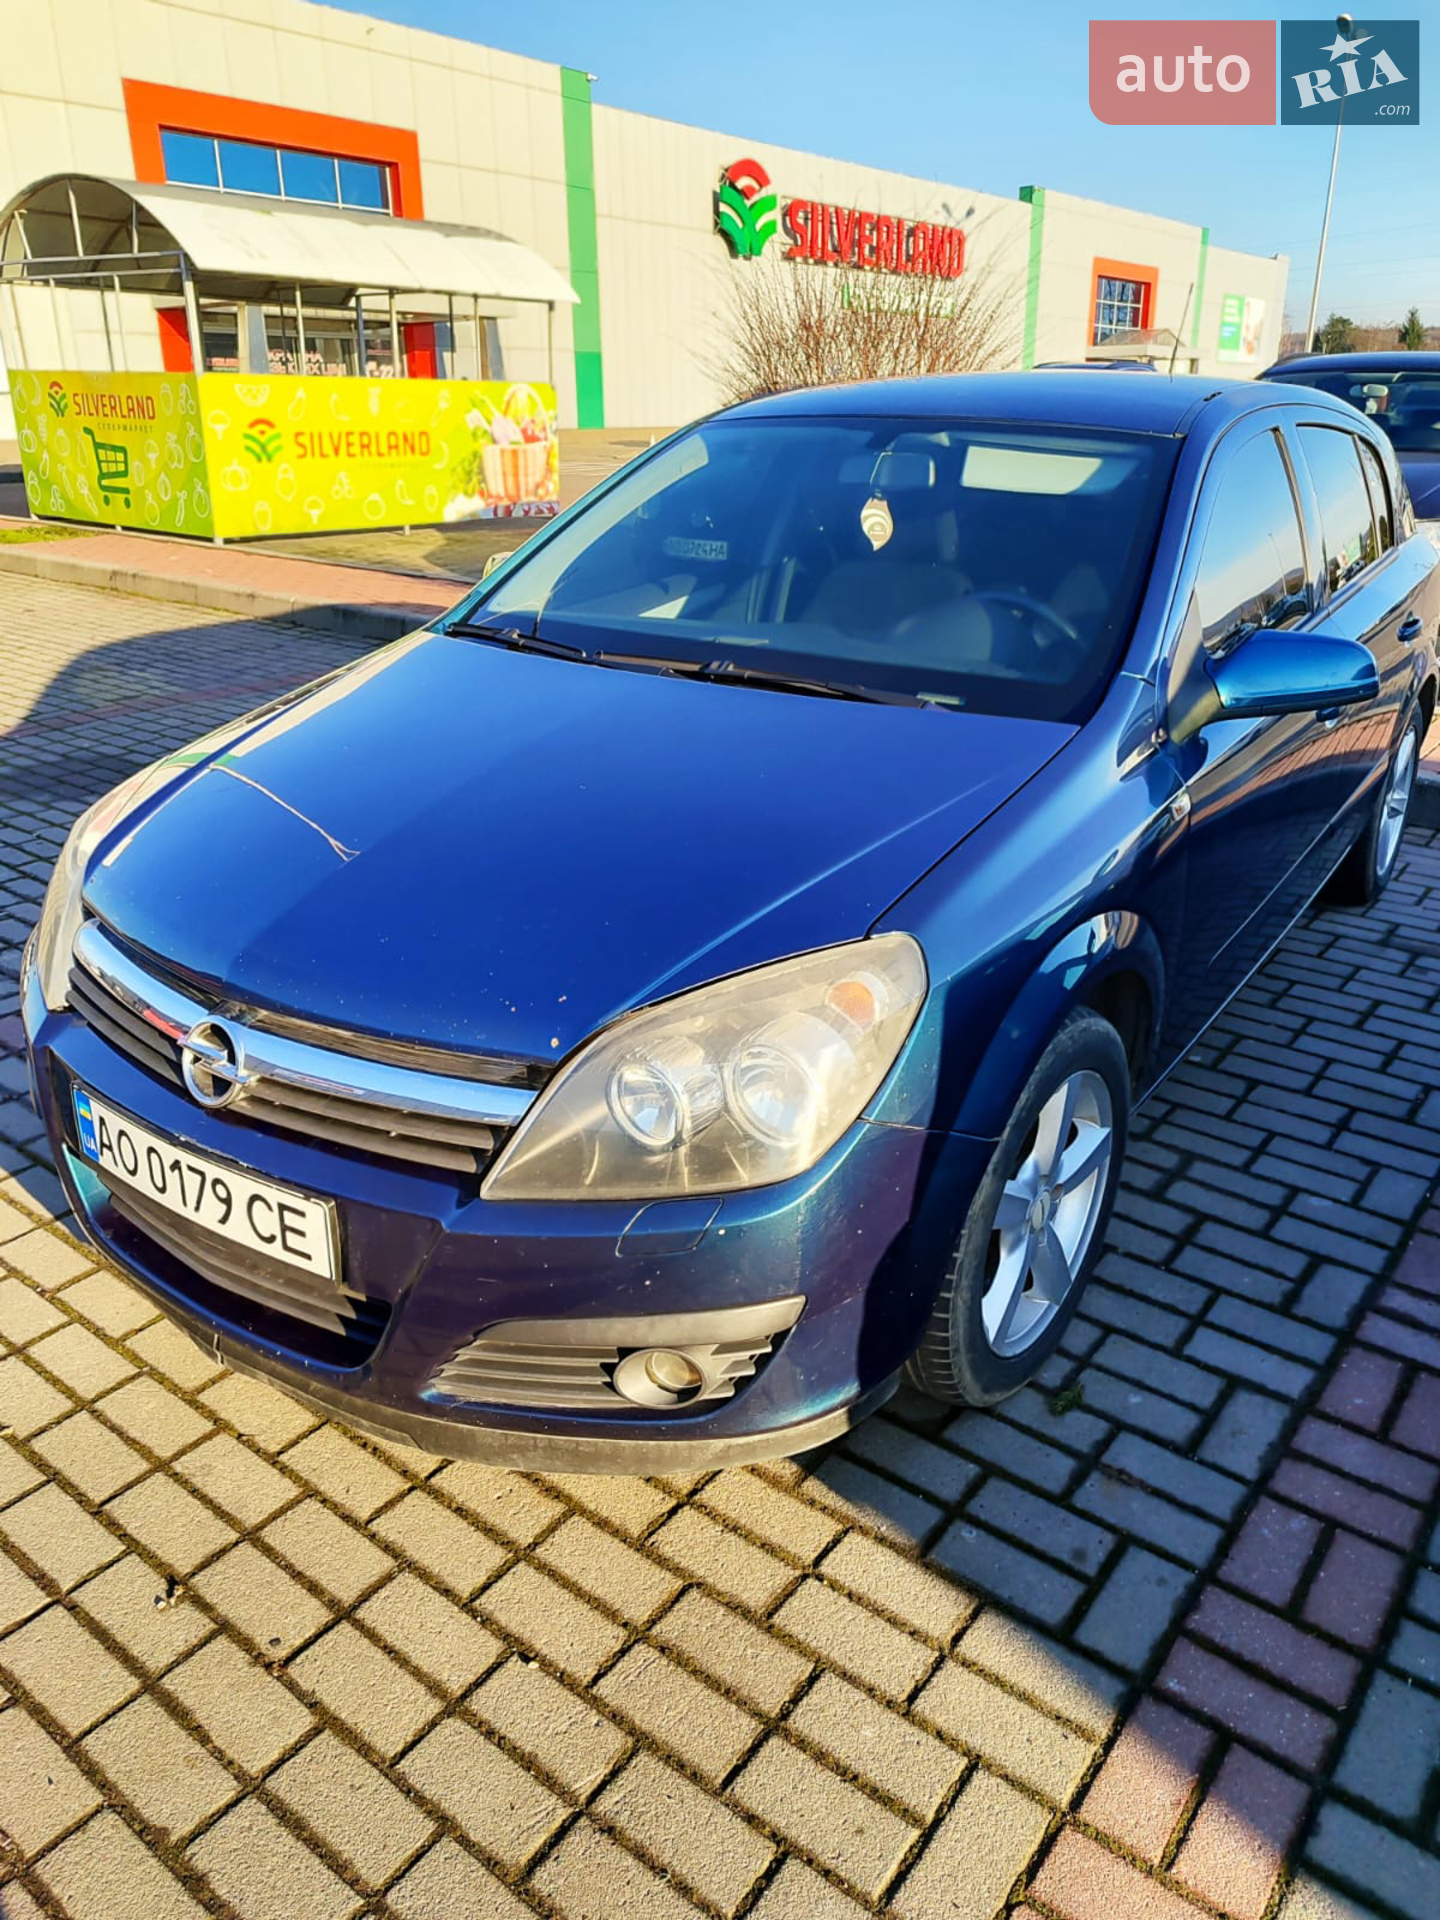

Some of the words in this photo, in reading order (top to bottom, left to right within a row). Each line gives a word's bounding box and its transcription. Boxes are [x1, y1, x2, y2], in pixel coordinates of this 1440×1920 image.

[787, 198, 967, 278] SILVERLAND
[73, 392, 156, 420] SILVERLAND
[294, 431, 431, 459] SILVERLAND
[84, 1132, 98, 1152] UA
[98, 1115, 138, 1177] AO
[147, 1147, 232, 1225] 0179
[247, 1194, 312, 1261] CE
